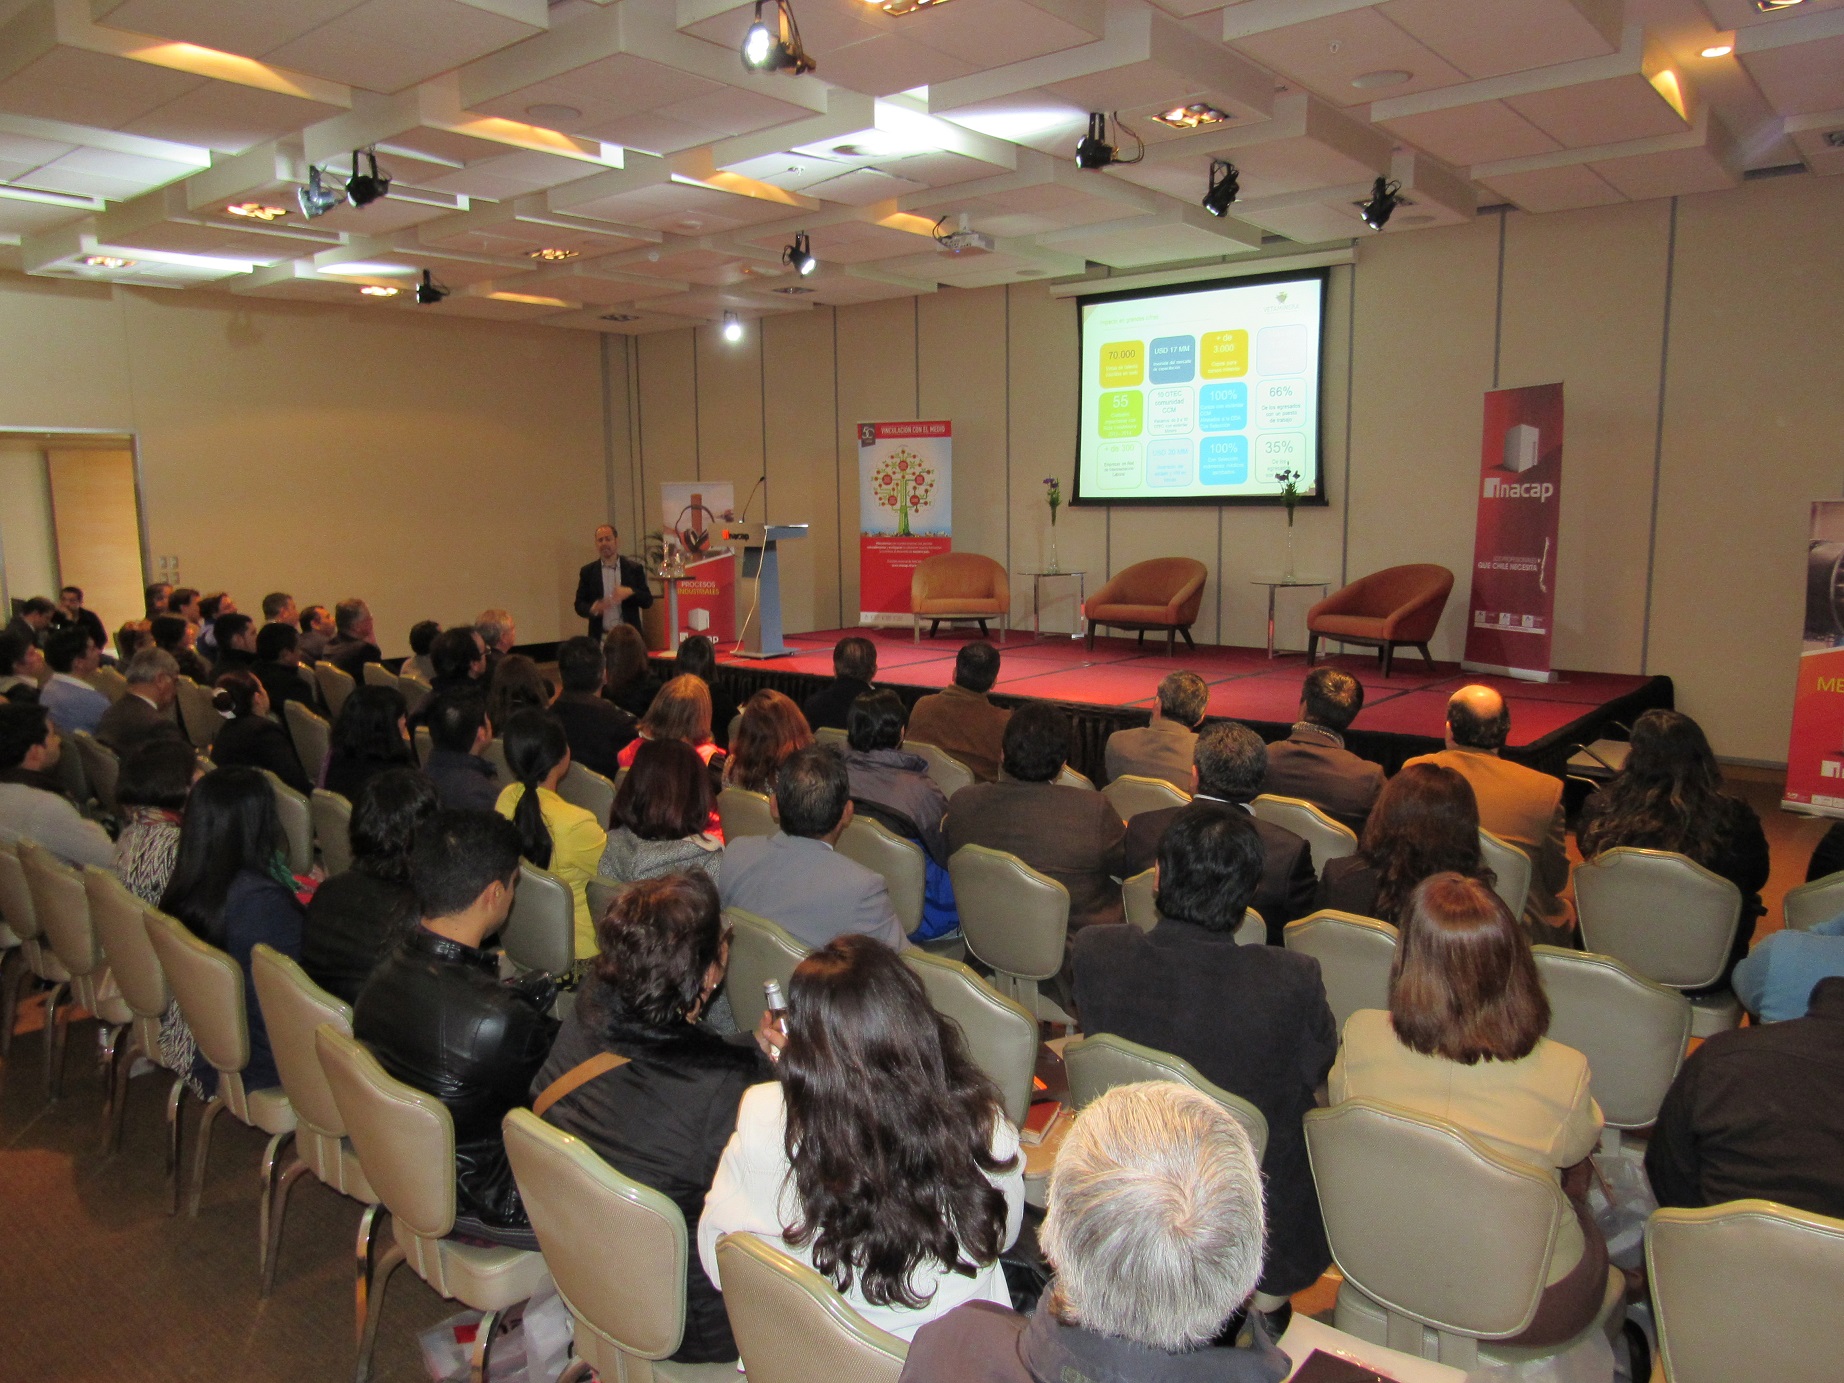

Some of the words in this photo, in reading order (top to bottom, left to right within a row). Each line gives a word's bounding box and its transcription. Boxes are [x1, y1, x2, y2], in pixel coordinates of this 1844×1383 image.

[1223, 334, 1232, 342] de
[1213, 344, 1234, 353] 3.000
[1109, 349, 1136, 360] 70.000
[1210, 389, 1238, 401] 100%
[1269, 386, 1293, 397] 66%
[1112, 394, 1128, 409] 55
[1155, 398, 1184, 406] comunidad
[881, 426, 911, 434] VINCULACIÓN
[930, 425, 945, 433] MEDIO
[1210, 443, 1238, 454] 100%
[1265, 440, 1294, 454] 35%
[1492, 562, 1508, 570] CHILE
[1509, 563, 1537, 571] NECESITA
